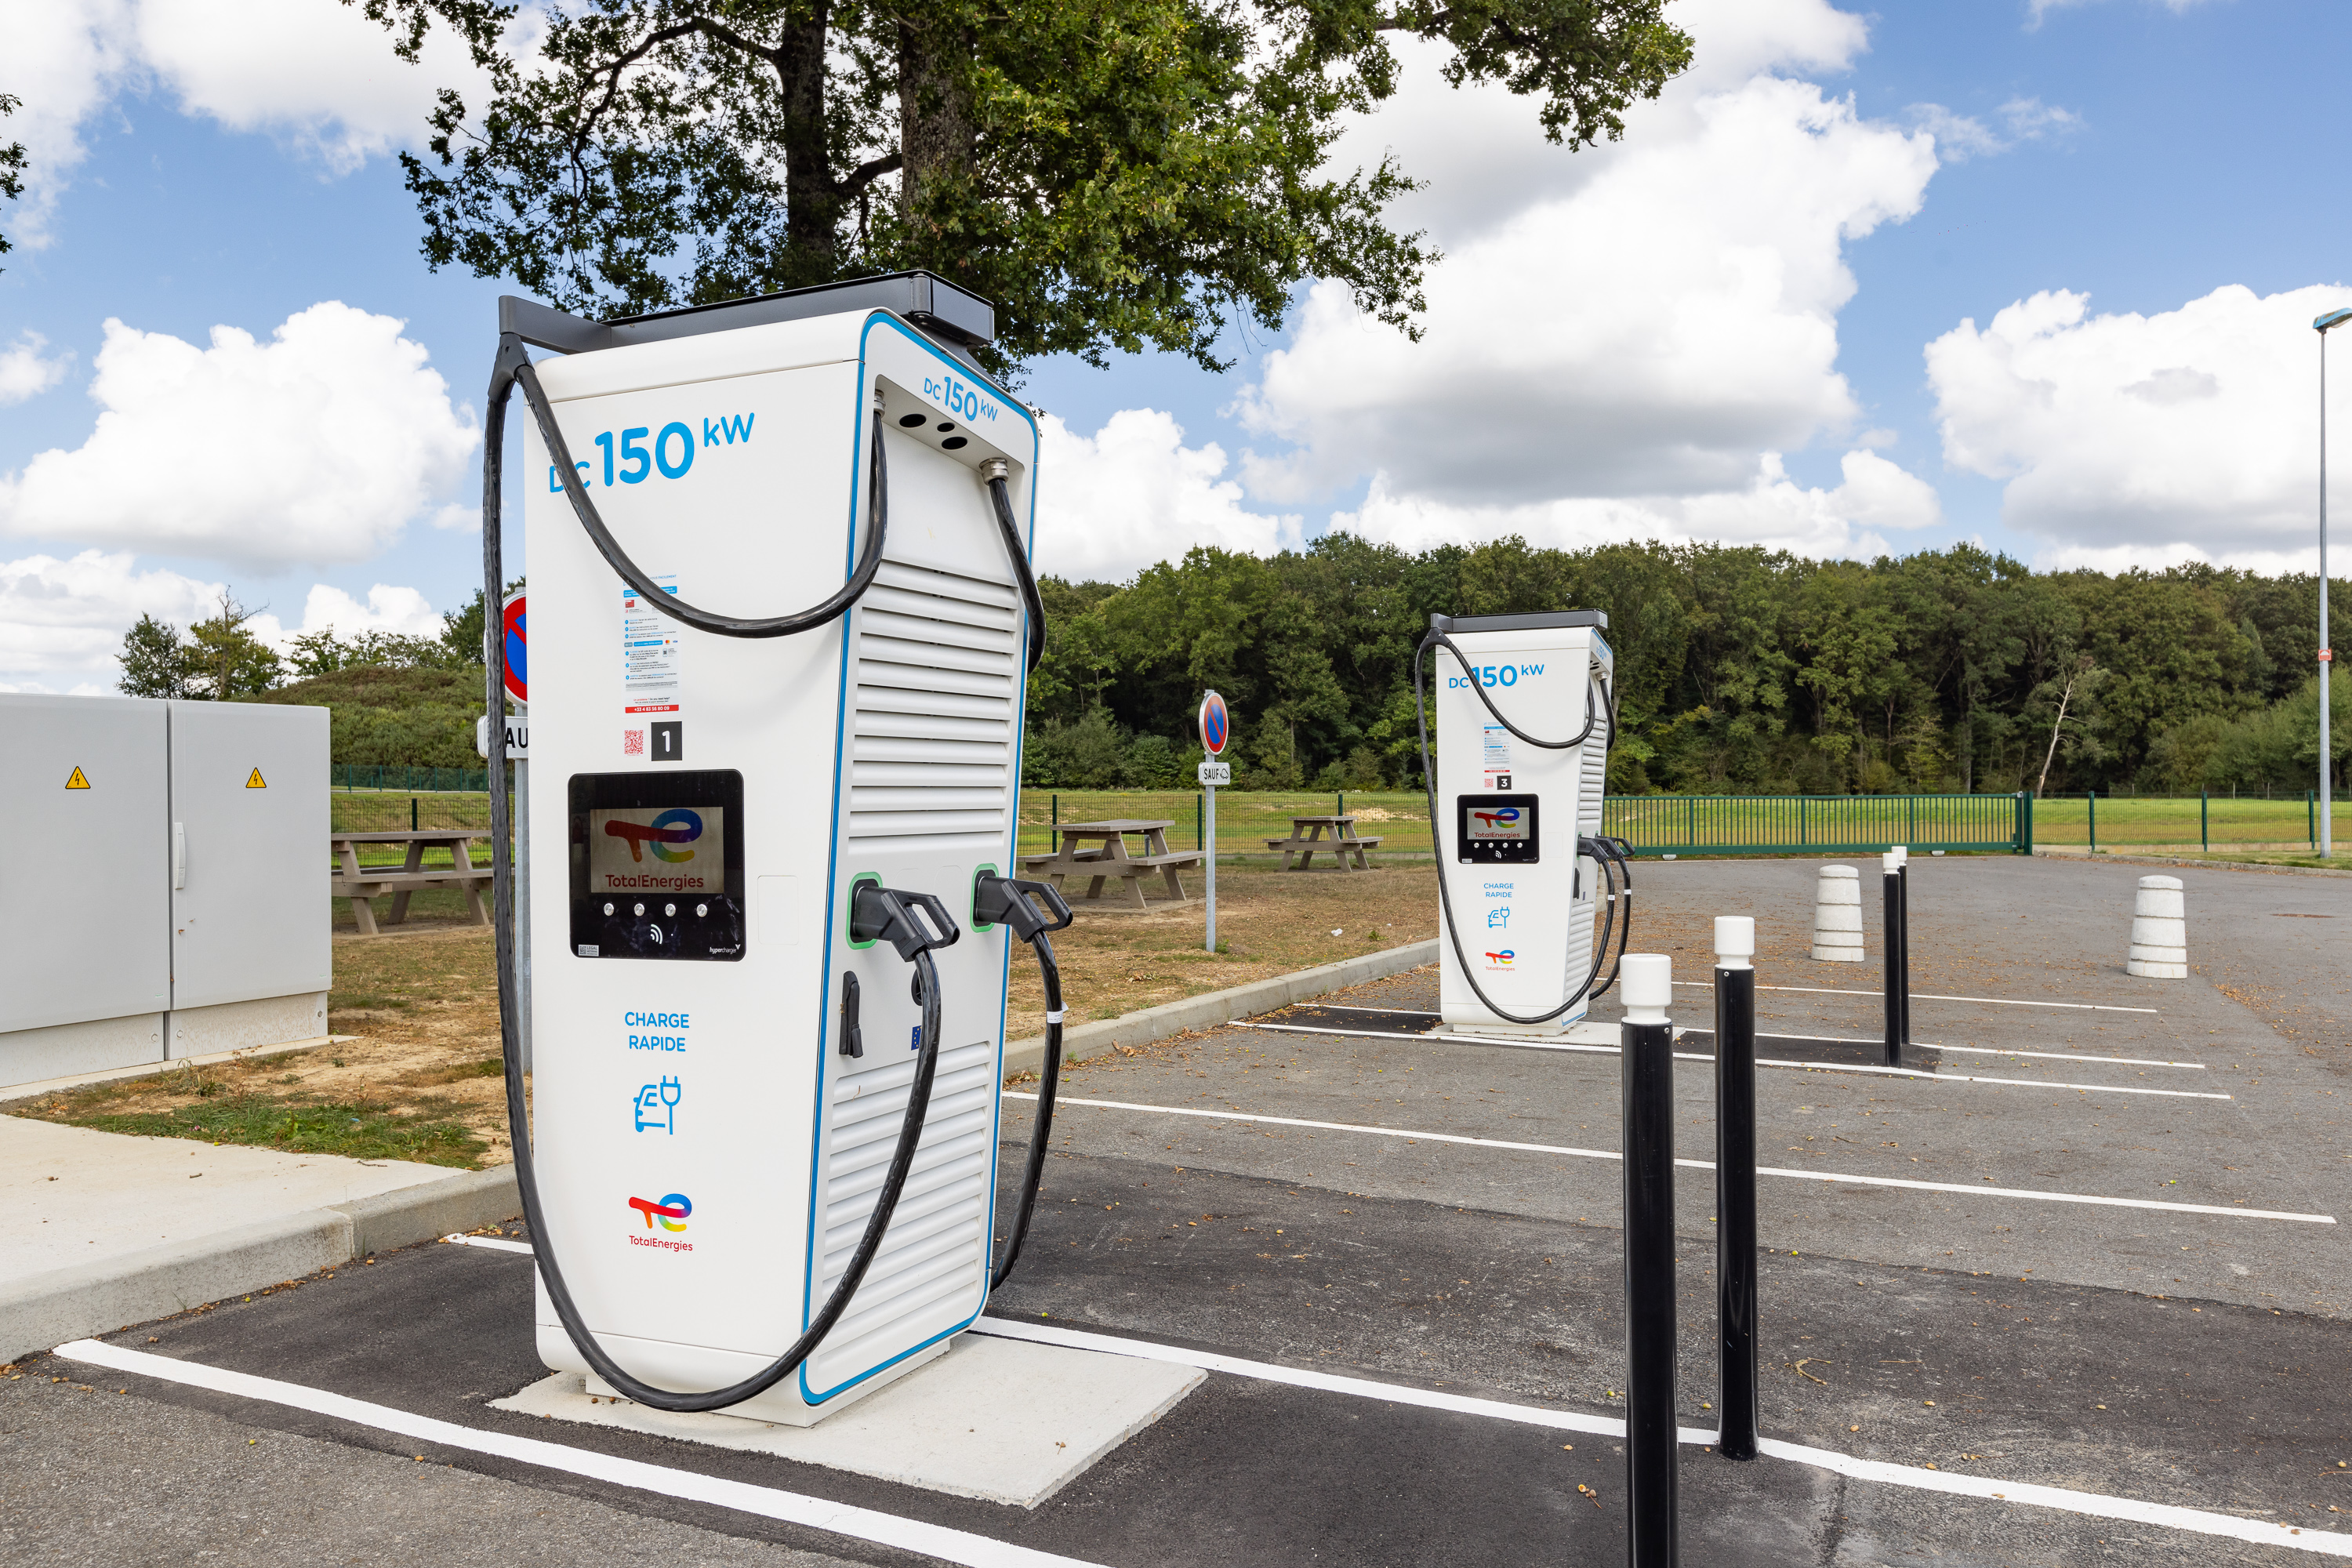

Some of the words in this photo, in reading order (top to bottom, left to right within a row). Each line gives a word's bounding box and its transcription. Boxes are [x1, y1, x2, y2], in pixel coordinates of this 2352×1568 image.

[924, 377, 941, 401] DC
[944, 376, 978, 422] 150
[980, 398, 998, 422] kW
[594, 422, 695, 487] 150
[703, 412, 755, 448] kW
[1449, 677, 1469, 688] DC
[1472, 665, 1518, 688] 150
[1521, 664, 1544, 676] kW
[506, 727, 528, 749] AU
[662, 730, 670, 752] 1
[1203, 768, 1219, 780] SAUF
[1501, 779, 1508, 787] 3
[605, 874, 704, 891] TotalEnergies
[710, 946, 736, 955] hypercharger
[625, 1011, 690, 1029] CHARGE
[629, 1035, 686, 1052] RAPIDE
[629, 1235, 693, 1252] TotalEnergies
